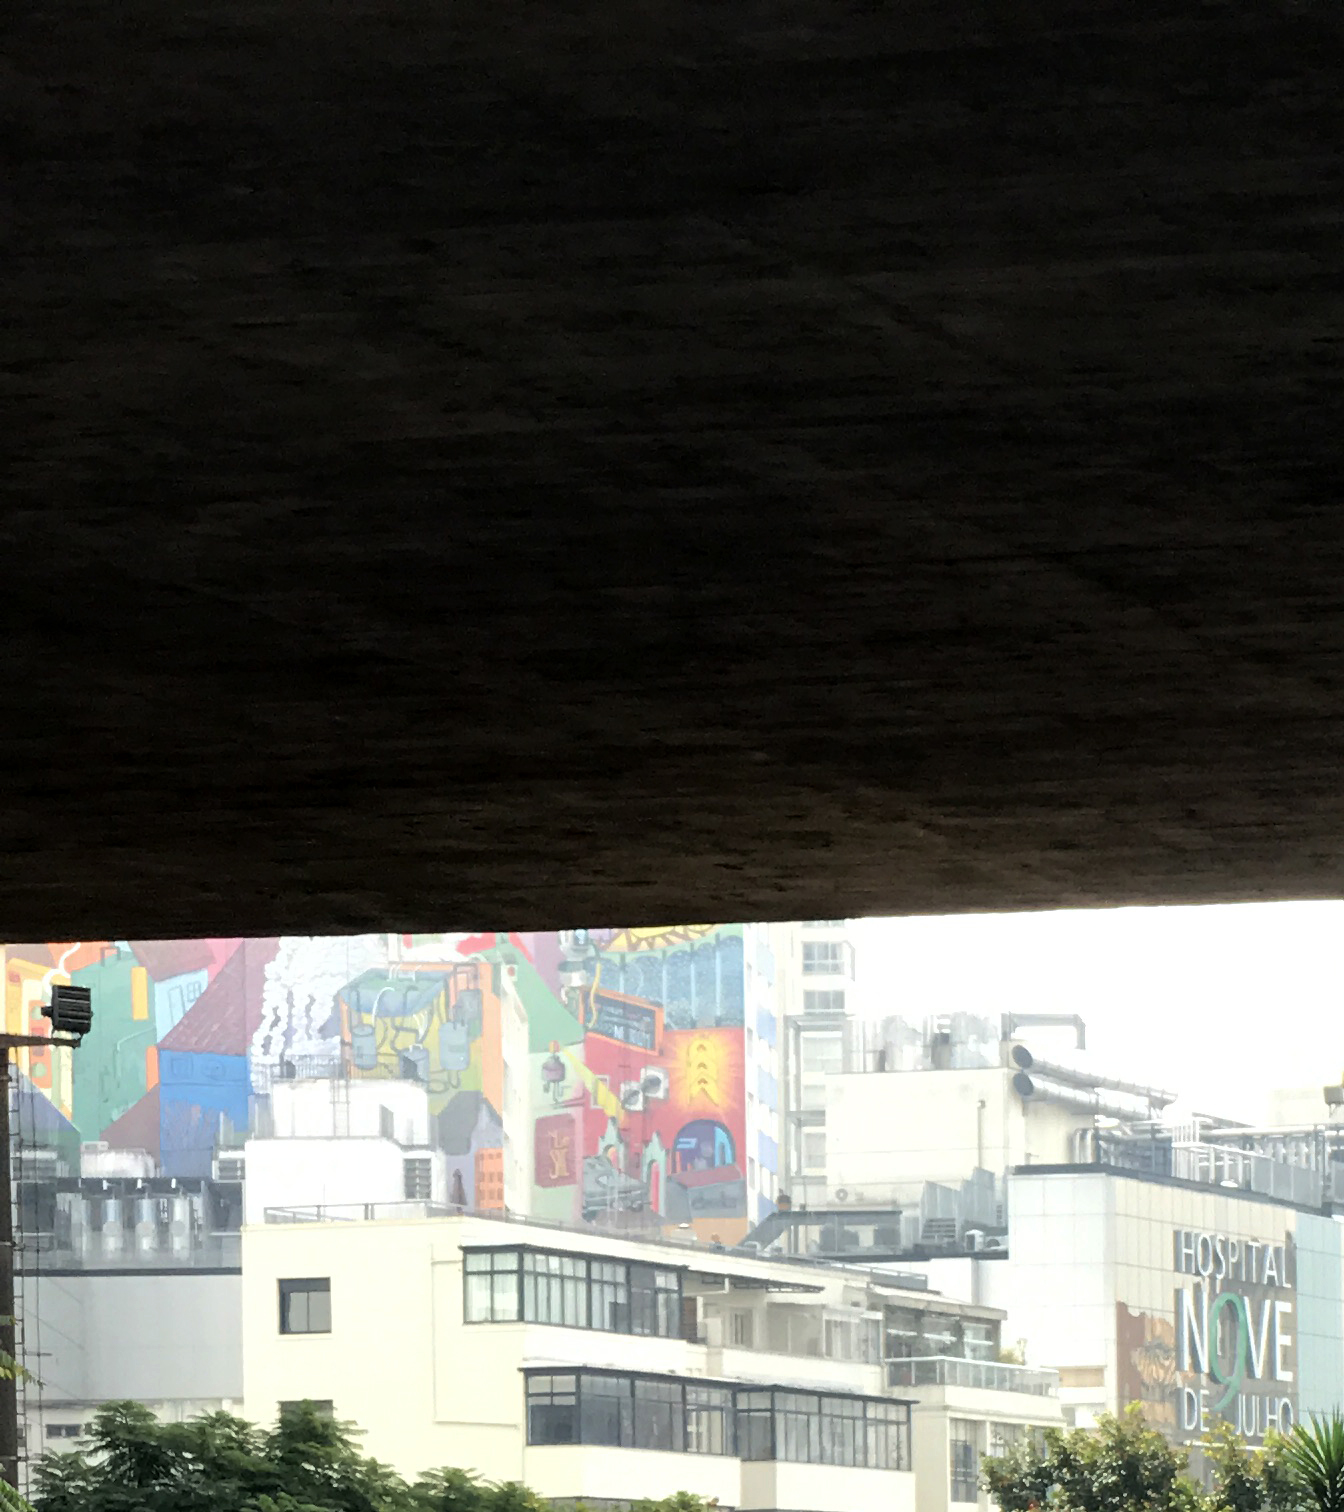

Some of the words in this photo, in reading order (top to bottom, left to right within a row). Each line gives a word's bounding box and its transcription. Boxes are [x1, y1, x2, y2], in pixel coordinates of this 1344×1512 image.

[1180, 1229, 1292, 1289] HOSPITAL
[1184, 1387, 1210, 1432] DE
[1236, 1393, 1294, 1437] JULHO
